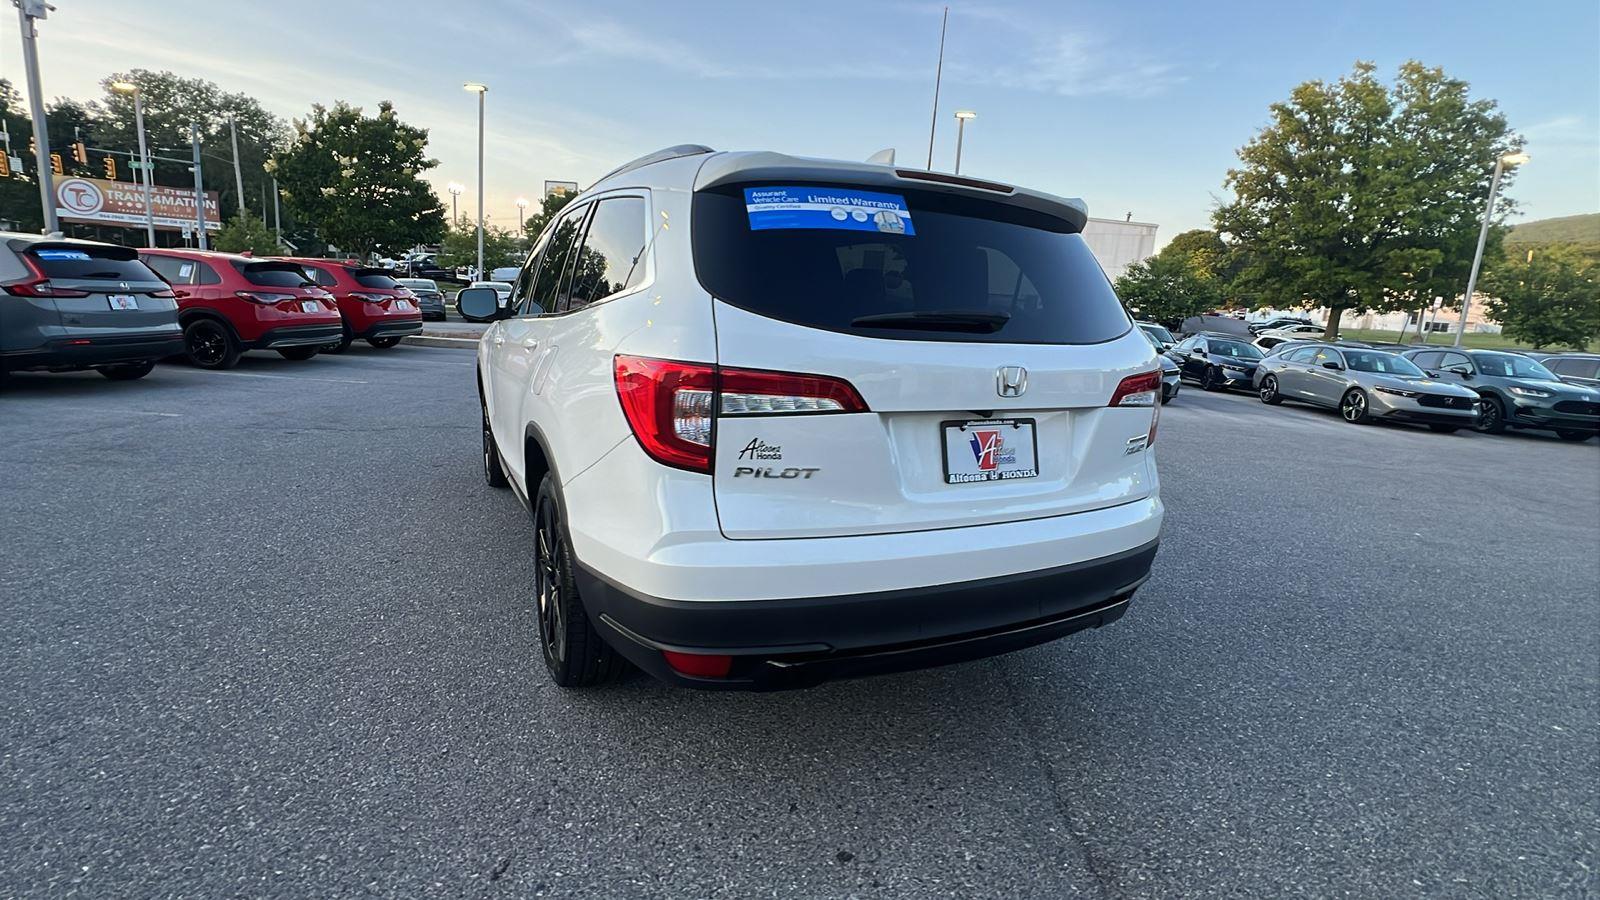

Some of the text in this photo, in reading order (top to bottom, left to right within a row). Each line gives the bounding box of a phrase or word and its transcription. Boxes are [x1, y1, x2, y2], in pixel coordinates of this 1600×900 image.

[807, 195, 900, 212] Limited Warranty
[756, 452, 782, 460] Honda
[734, 466, 821, 479] PILOT
[949, 472, 987, 484] Altoona
[1001, 469, 1037, 479] HONDA
